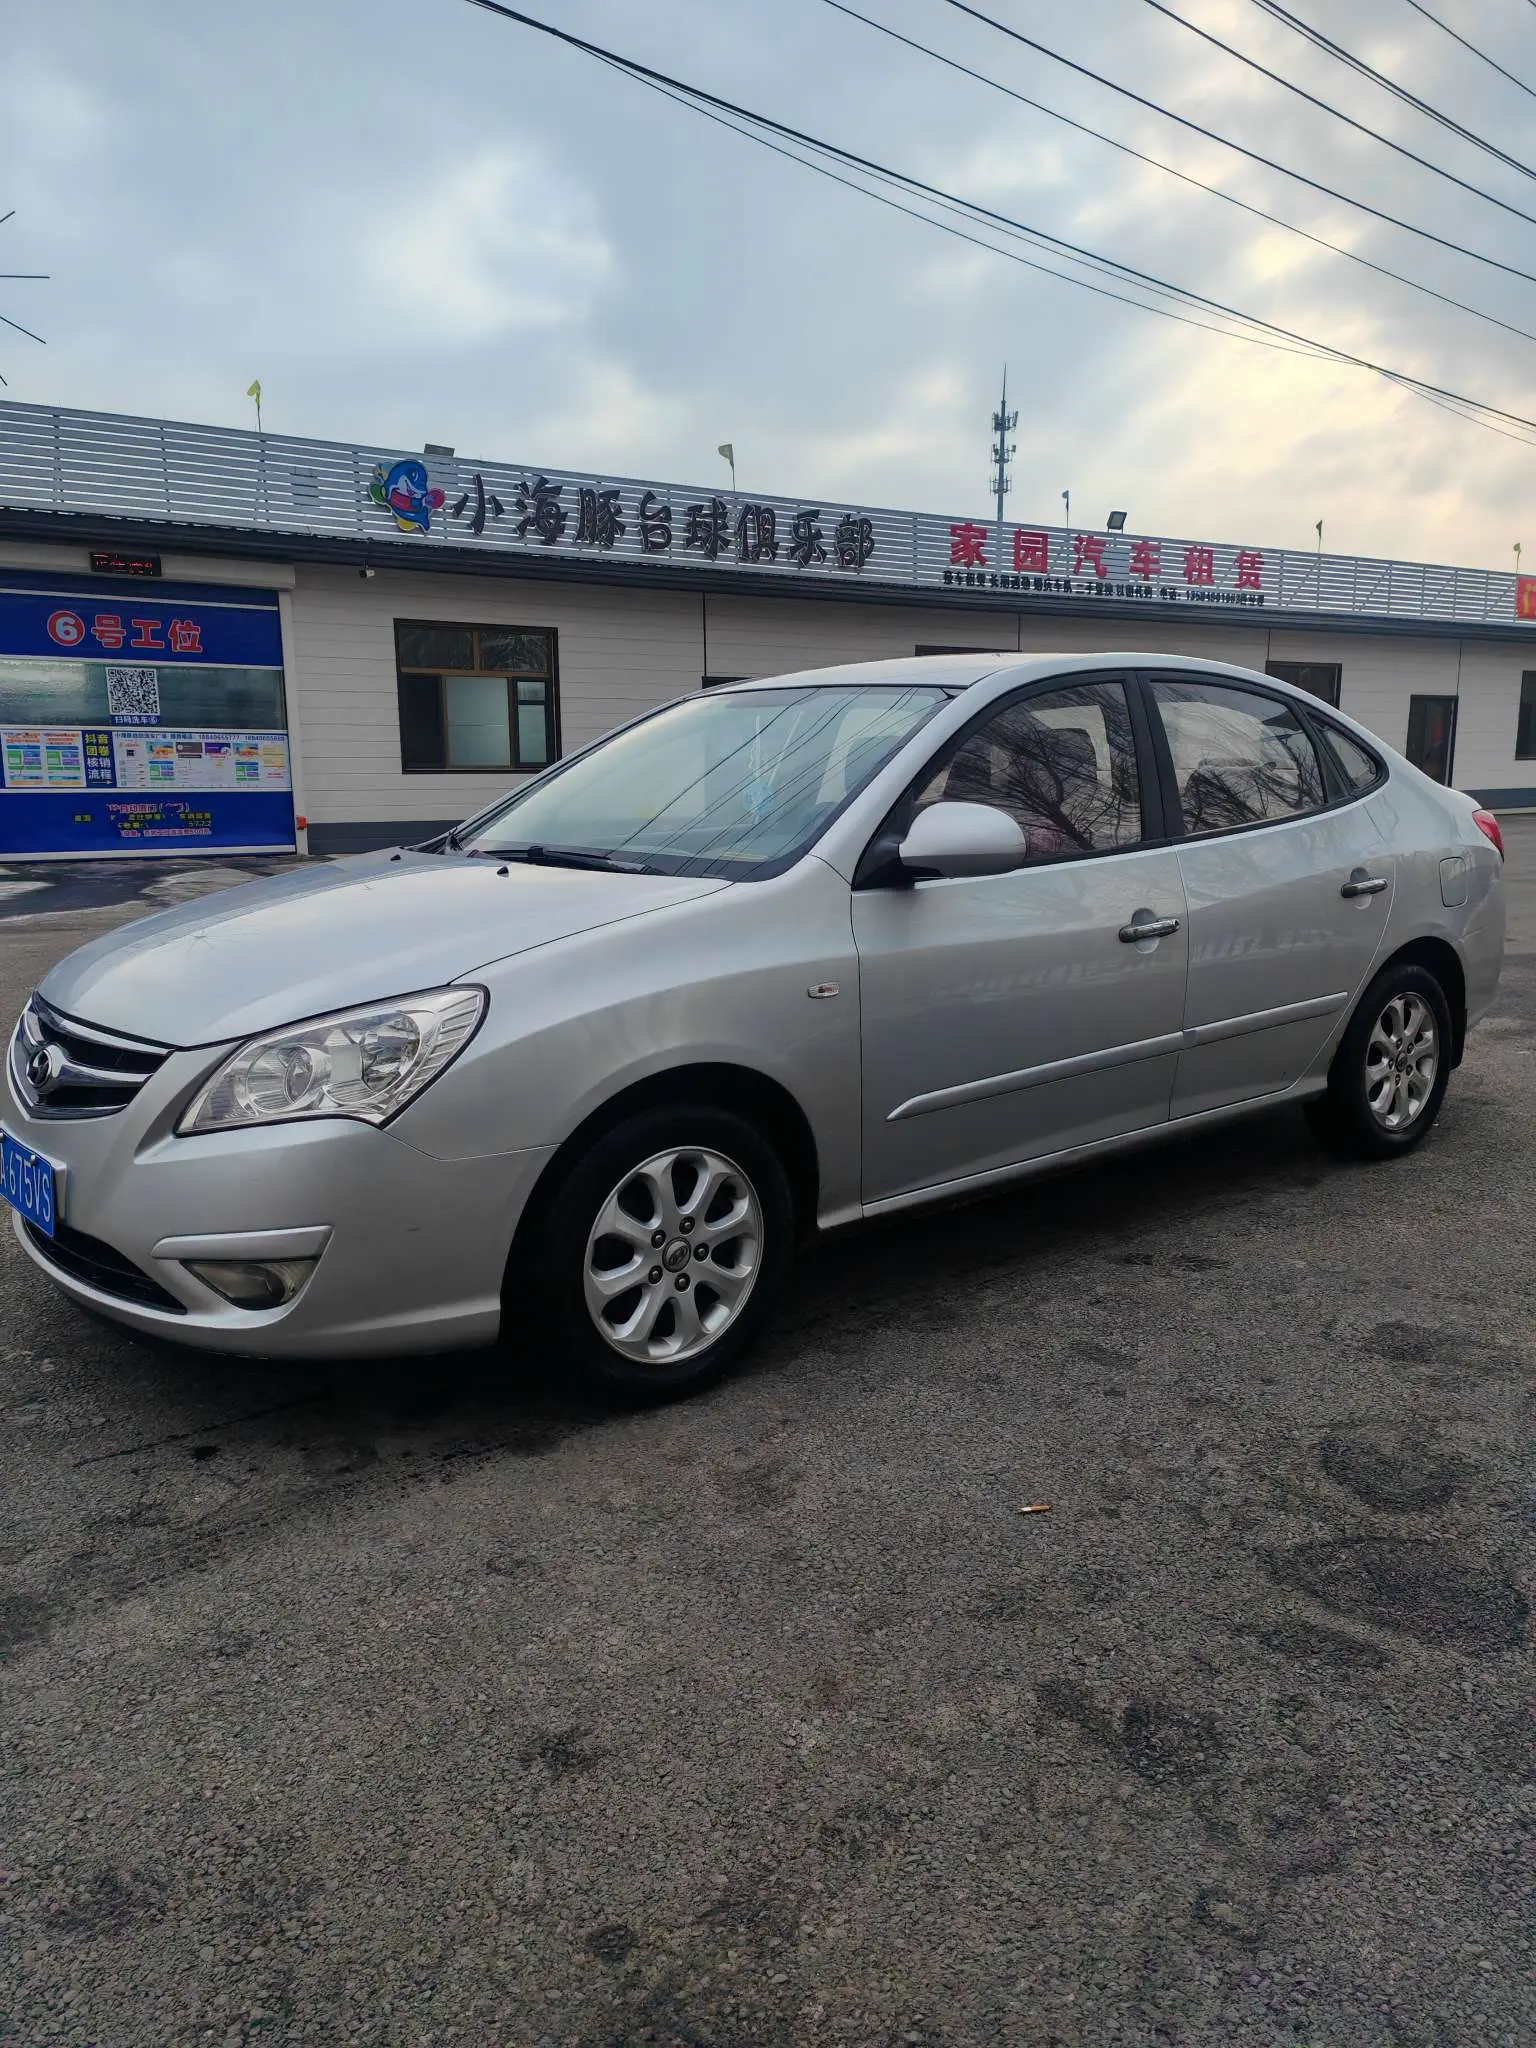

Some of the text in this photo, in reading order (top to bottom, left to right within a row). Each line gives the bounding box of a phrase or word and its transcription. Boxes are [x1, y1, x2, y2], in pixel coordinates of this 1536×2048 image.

[452, 472, 874, 568] 小海豚台球俱乐部
[950, 522, 1265, 590] 家园汽车租赁
